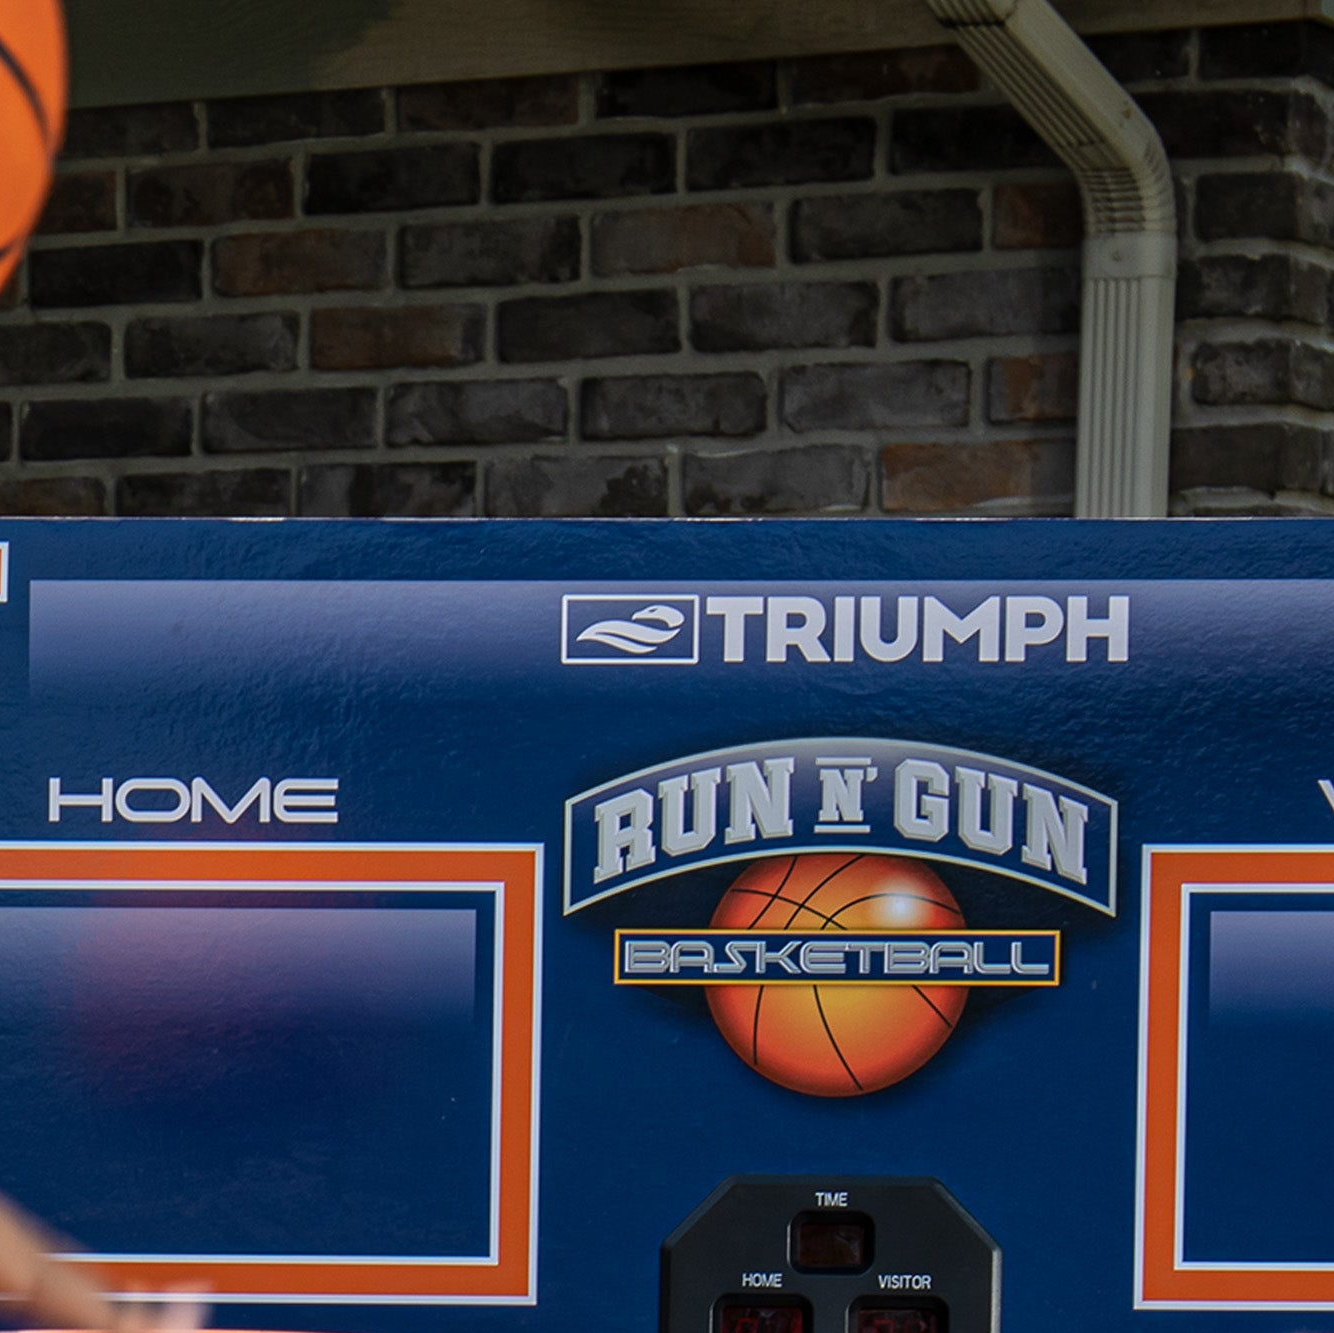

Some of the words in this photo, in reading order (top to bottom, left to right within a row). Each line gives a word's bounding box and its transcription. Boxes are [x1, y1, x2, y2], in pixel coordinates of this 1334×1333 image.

[706, 596, 1129, 662] TRIUMPH
[48, 777, 339, 824] HOME
[593, 756, 795, 884] RUN
[894, 758, 1089, 885] GUN
[624, 940, 1050, 975] BASKETBALL
[815, 1192, 848, 1207] TIME
[742, 1273, 782, 1287] HOME
[878, 1275, 931, 1289] VISITOR
